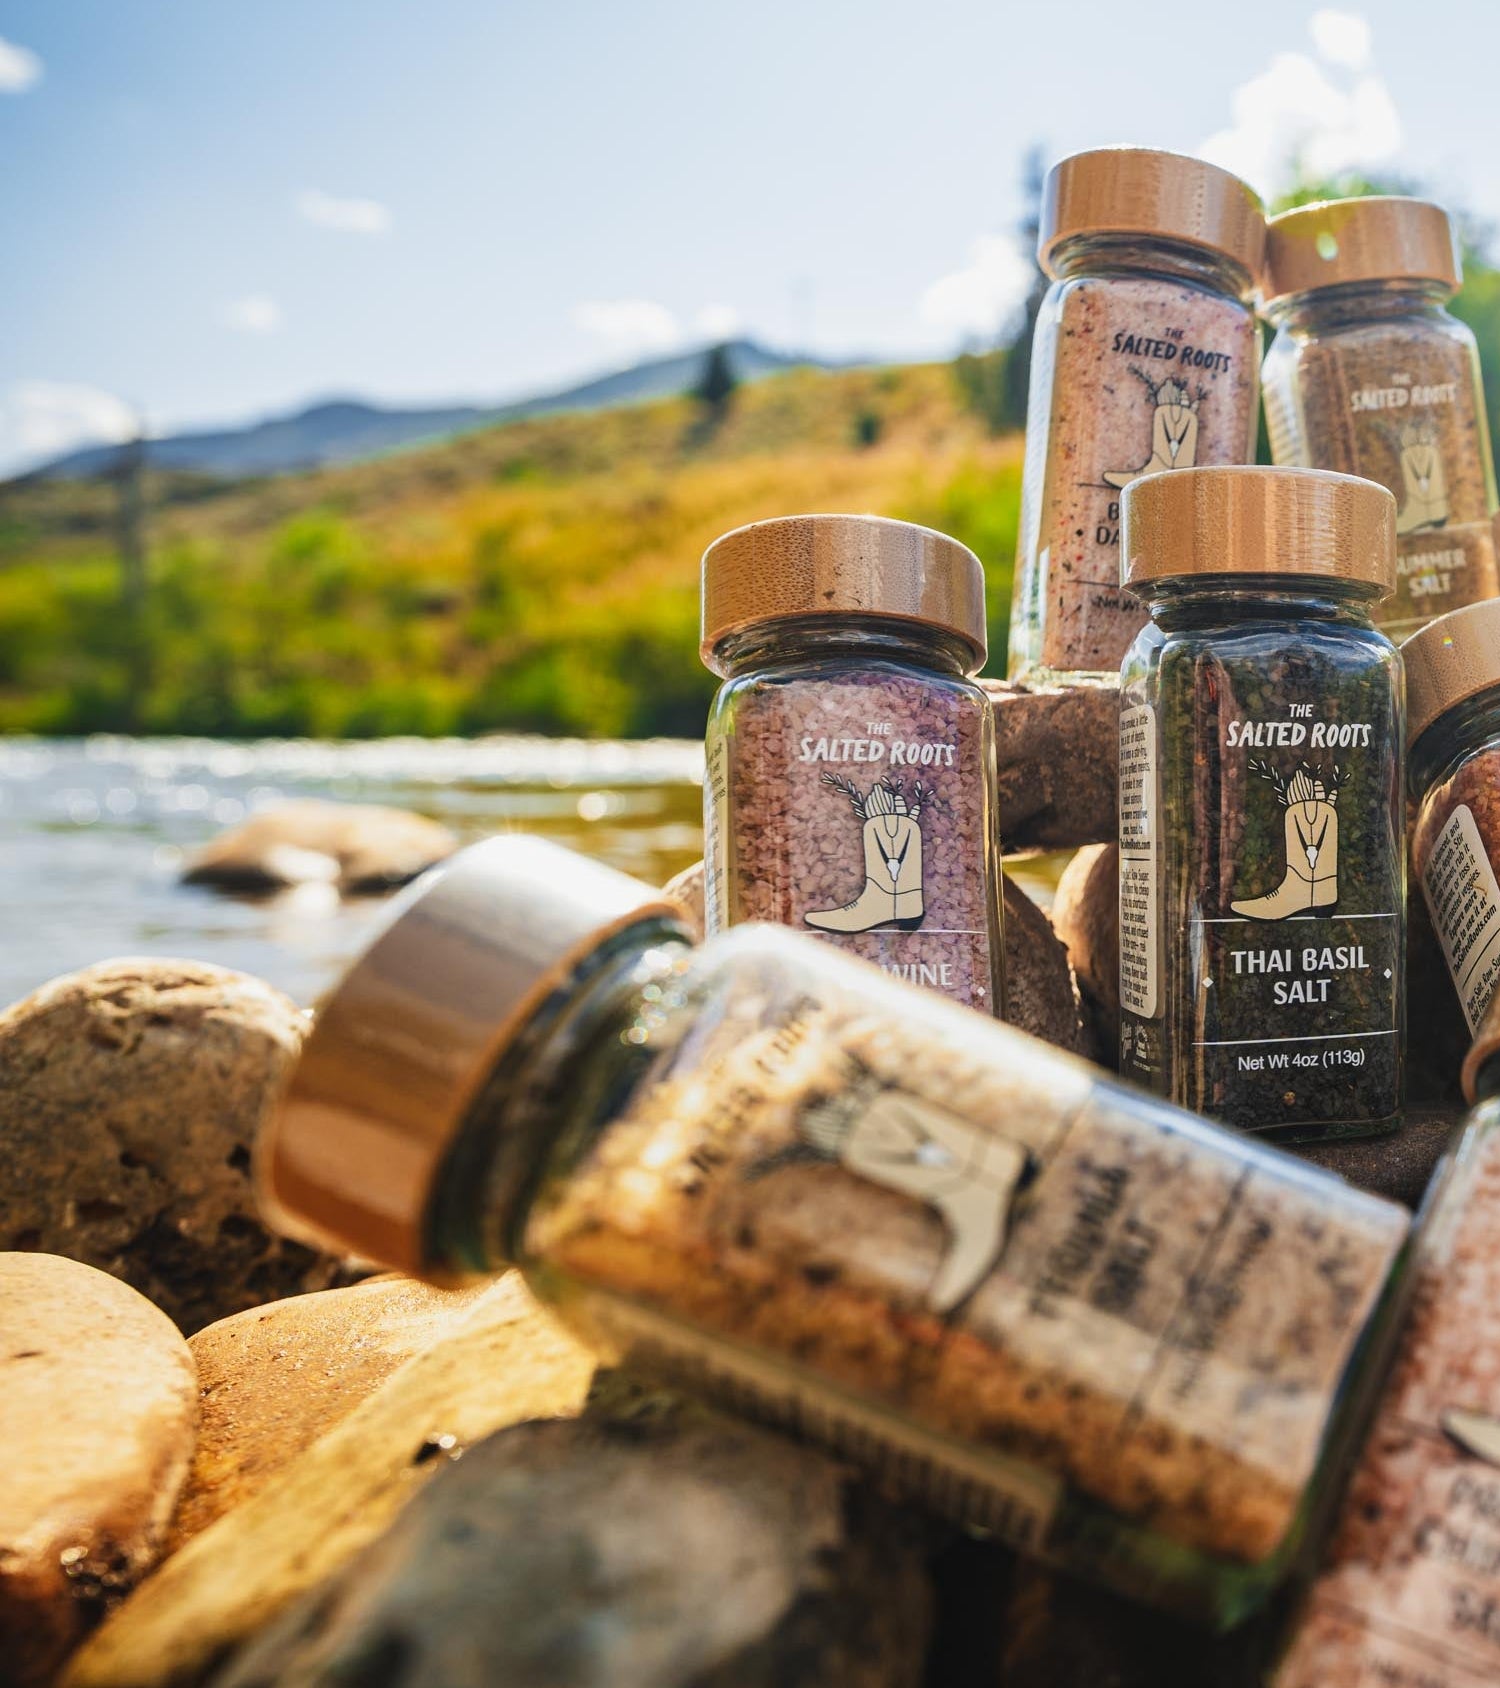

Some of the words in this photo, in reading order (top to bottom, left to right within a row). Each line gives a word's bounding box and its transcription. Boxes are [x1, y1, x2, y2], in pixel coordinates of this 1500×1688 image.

[1165, 327, 1185, 339] THE
[1112, 333, 1177, 360] SALTED
[1180, 346, 1232, 373] ROOTS
[1352, 388, 1408, 411] SALTED
[1411, 384, 1456, 406] ROOTS
[1288, 704, 1313, 718] THE
[866, 722, 892, 735] THE
[1225, 721, 1305, 749] SALTED
[1310, 723, 1371, 748] ROOTS
[799, 738, 884, 762] SALTED
[890, 743, 956, 766] ROOTS
[1464, 890, 1478, 911] more
[1467, 915, 1476, 929] use
[1480, 896, 1488, 910] at
[1230, 950, 1292, 975] THAI
[1301, 946, 1370, 971] BASIL
[1273, 978, 1331, 1005] SALT
[1238, 1054, 1264, 1072] Net
[1268, 1053, 1289, 1070] Wt
[1292, 1052, 1318, 1068] 4oz
[1322, 1050, 1365, 1070] (113g)
